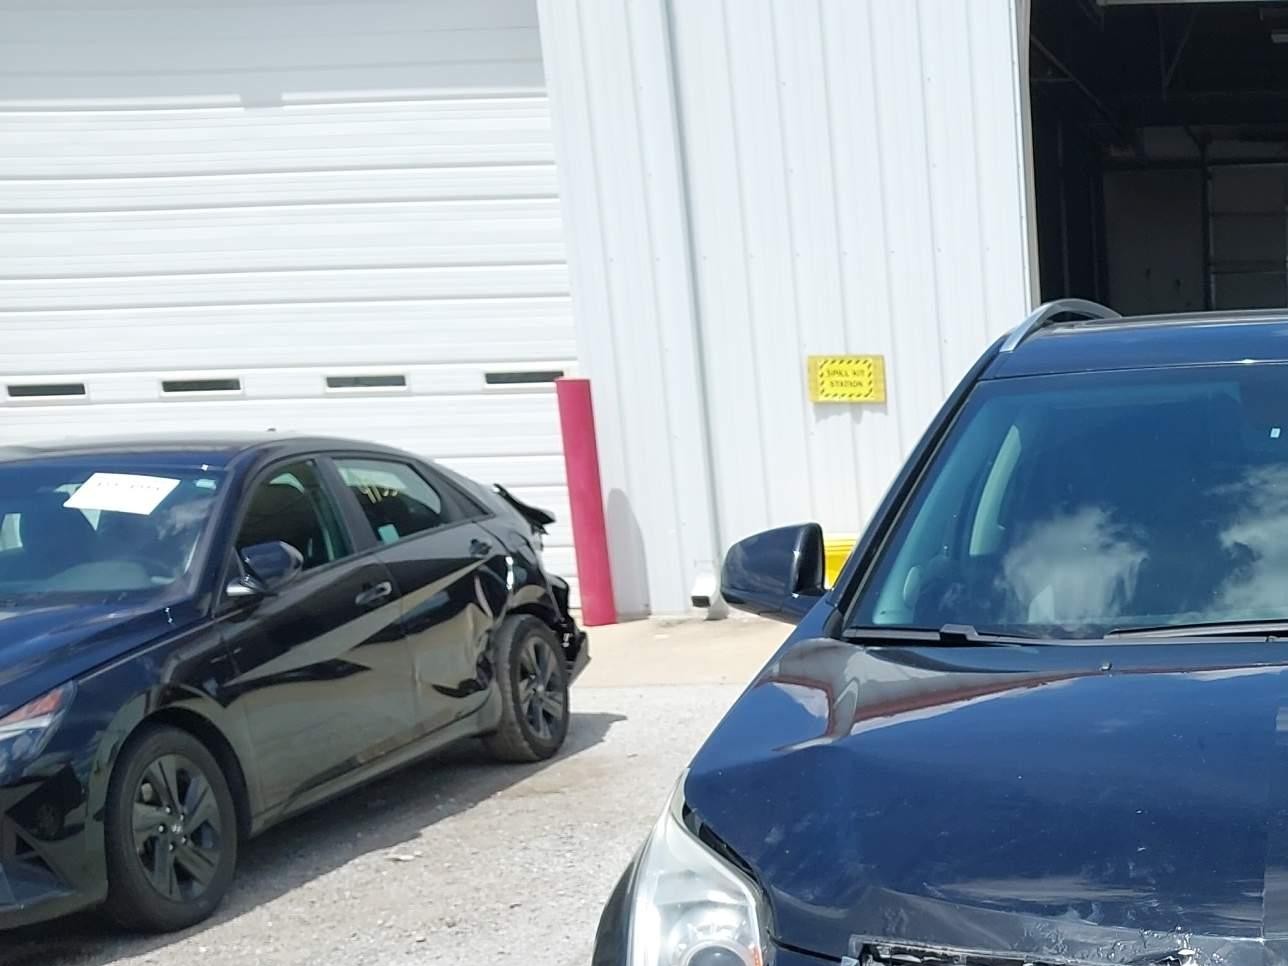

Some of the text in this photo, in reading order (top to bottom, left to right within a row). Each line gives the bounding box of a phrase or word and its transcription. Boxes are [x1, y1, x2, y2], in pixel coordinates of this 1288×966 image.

[826, 368, 865, 377] SPILL KIT
[829, 380, 864, 388] STATION
